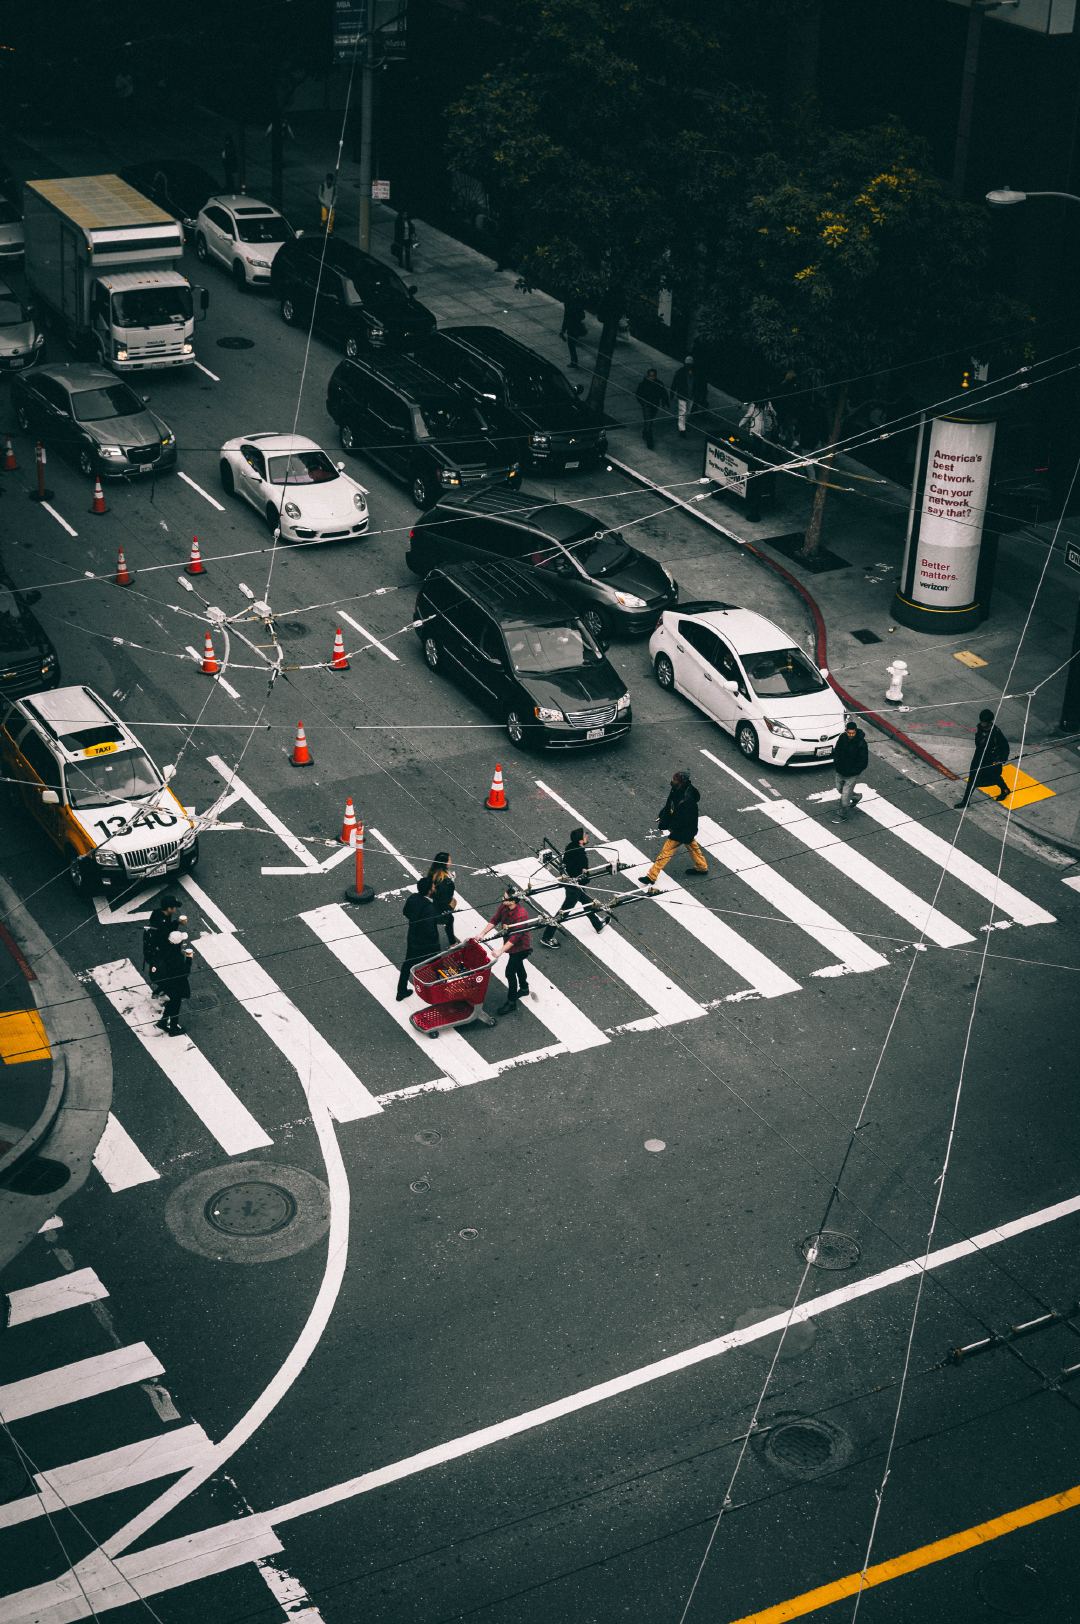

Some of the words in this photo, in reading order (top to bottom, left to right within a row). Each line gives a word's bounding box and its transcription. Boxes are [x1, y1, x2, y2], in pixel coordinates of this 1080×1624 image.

[714, 448, 726, 462] NO
[934, 450, 982, 462] America's
[933, 460, 954, 471] best
[932, 472, 975, 483] network.
[930, 484, 949, 496] Can
[951, 489, 973, 499] your
[928, 496, 969, 507] network
[928, 507, 944, 517] say
[946, 509, 971, 517] that?
[921, 559, 950, 571] Better
[920, 570, 958, 580] matters.
[920, 581, 948, 591] verizon
[95, 746, 111, 754] TAXI
[94, 810, 178, 838] 1340
